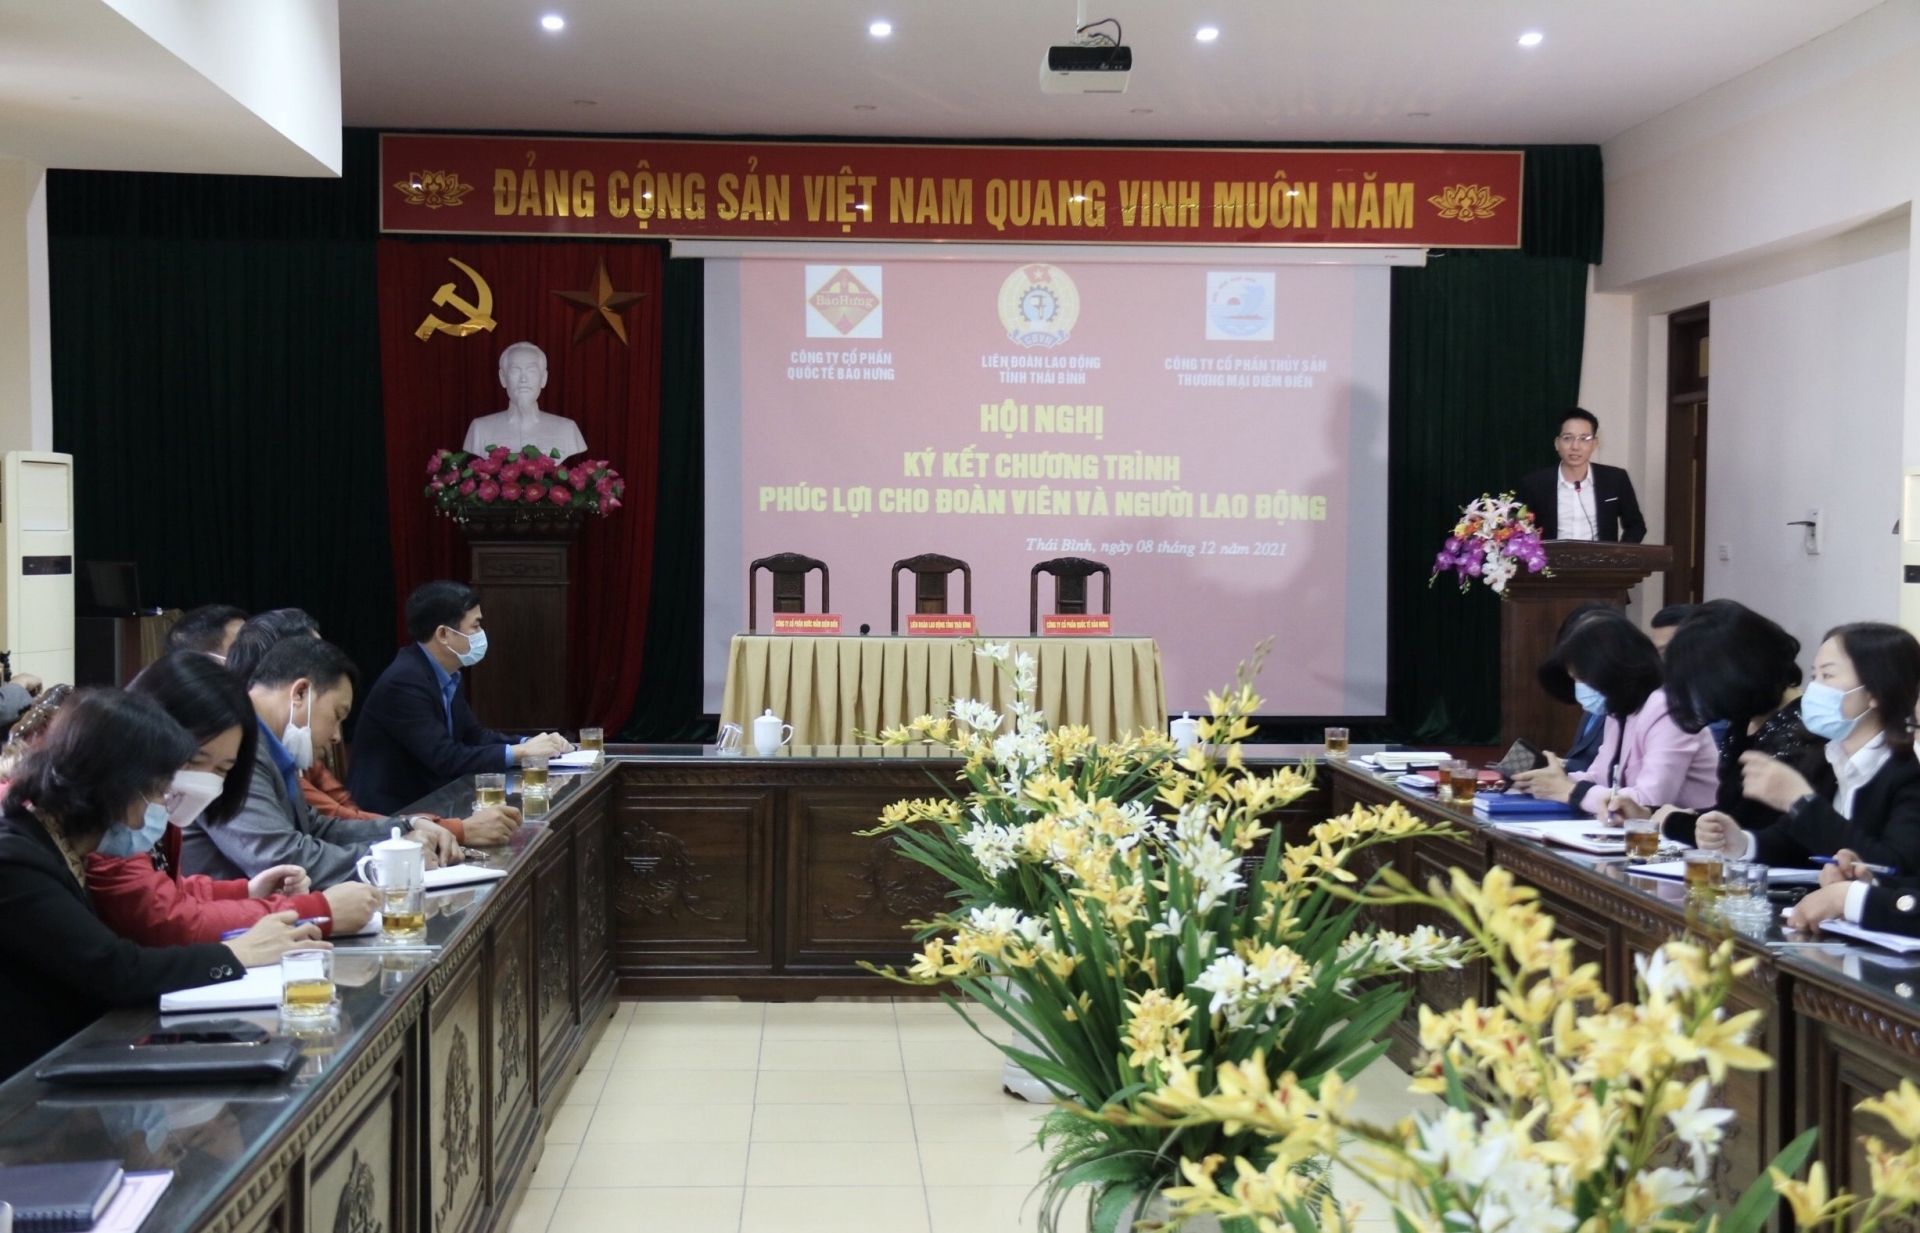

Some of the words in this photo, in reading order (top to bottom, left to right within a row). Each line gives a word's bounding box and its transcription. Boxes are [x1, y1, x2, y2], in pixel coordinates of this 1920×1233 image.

[493, 151, 594, 218] ĐẢNG
[608, 160, 706, 230] CỘNG
[718, 156, 790, 222] SẢN
[804, 165, 877, 233] VIỆT
[889, 176, 972, 224] NAM
[987, 178, 1106, 232] QUANG
[1119, 180, 1200, 228] VINH
[1213, 170, 1317, 229] MUÔN
[1332, 171, 1414, 229] NĂM
[790, 349, 824, 364] CÔNG
[826, 352, 839, 364] TY
[981, 353, 1008, 368] LIÊN
[1010, 353, 1042, 368] ĐOÀN
[1044, 356, 1067, 369] LAO
[1069, 355, 1102, 372] ĐỘNG
[1164, 355, 1198, 370] CÔNG
[1200, 358, 1214, 371] TY
[863, 366, 895, 380] HƯNG
[1030, 370, 1055, 384] THÁI
[1177, 373, 1224, 386] THƯƠNG
[1227, 374, 1250, 389] MẠI
[1252, 373, 1282, 388] DIÊM
[980, 398, 1028, 438] HỘI
[1035, 405, 1103, 440] NGHỊ
[904, 447, 936, 477] KÝ
[943, 444, 989, 478] KẾT
[995, 450, 1098, 479] CHƯƠNG
[1104, 450, 1180, 481] TRÌNH
[759, 482, 827, 512] PHÚC
[833, 486, 872, 518] LỢI
[878, 488, 929, 513] CHO
[936, 484, 1006, 514] ĐOÀN
[1011, 485, 1071, 515] VIÊN
[1076, 486, 1109, 516] VÀ
[1116, 485, 1194, 518] NGƯỜI
[1200, 494, 1248, 519] LAO
[1254, 490, 1327, 526] ĐỘNG
[1026, 537, 1058, 552] Thái
[1061, 538, 1096, 554] Bình,
[1100, 539, 1133, 556] ngày
[1136, 540, 1154, 554] 08
[1157, 540, 1195, 557] tháng
[1199, 541, 1216, 555] 12
[1220, 543, 1249, 556] năm
[1252, 542, 1286, 556] 2021
